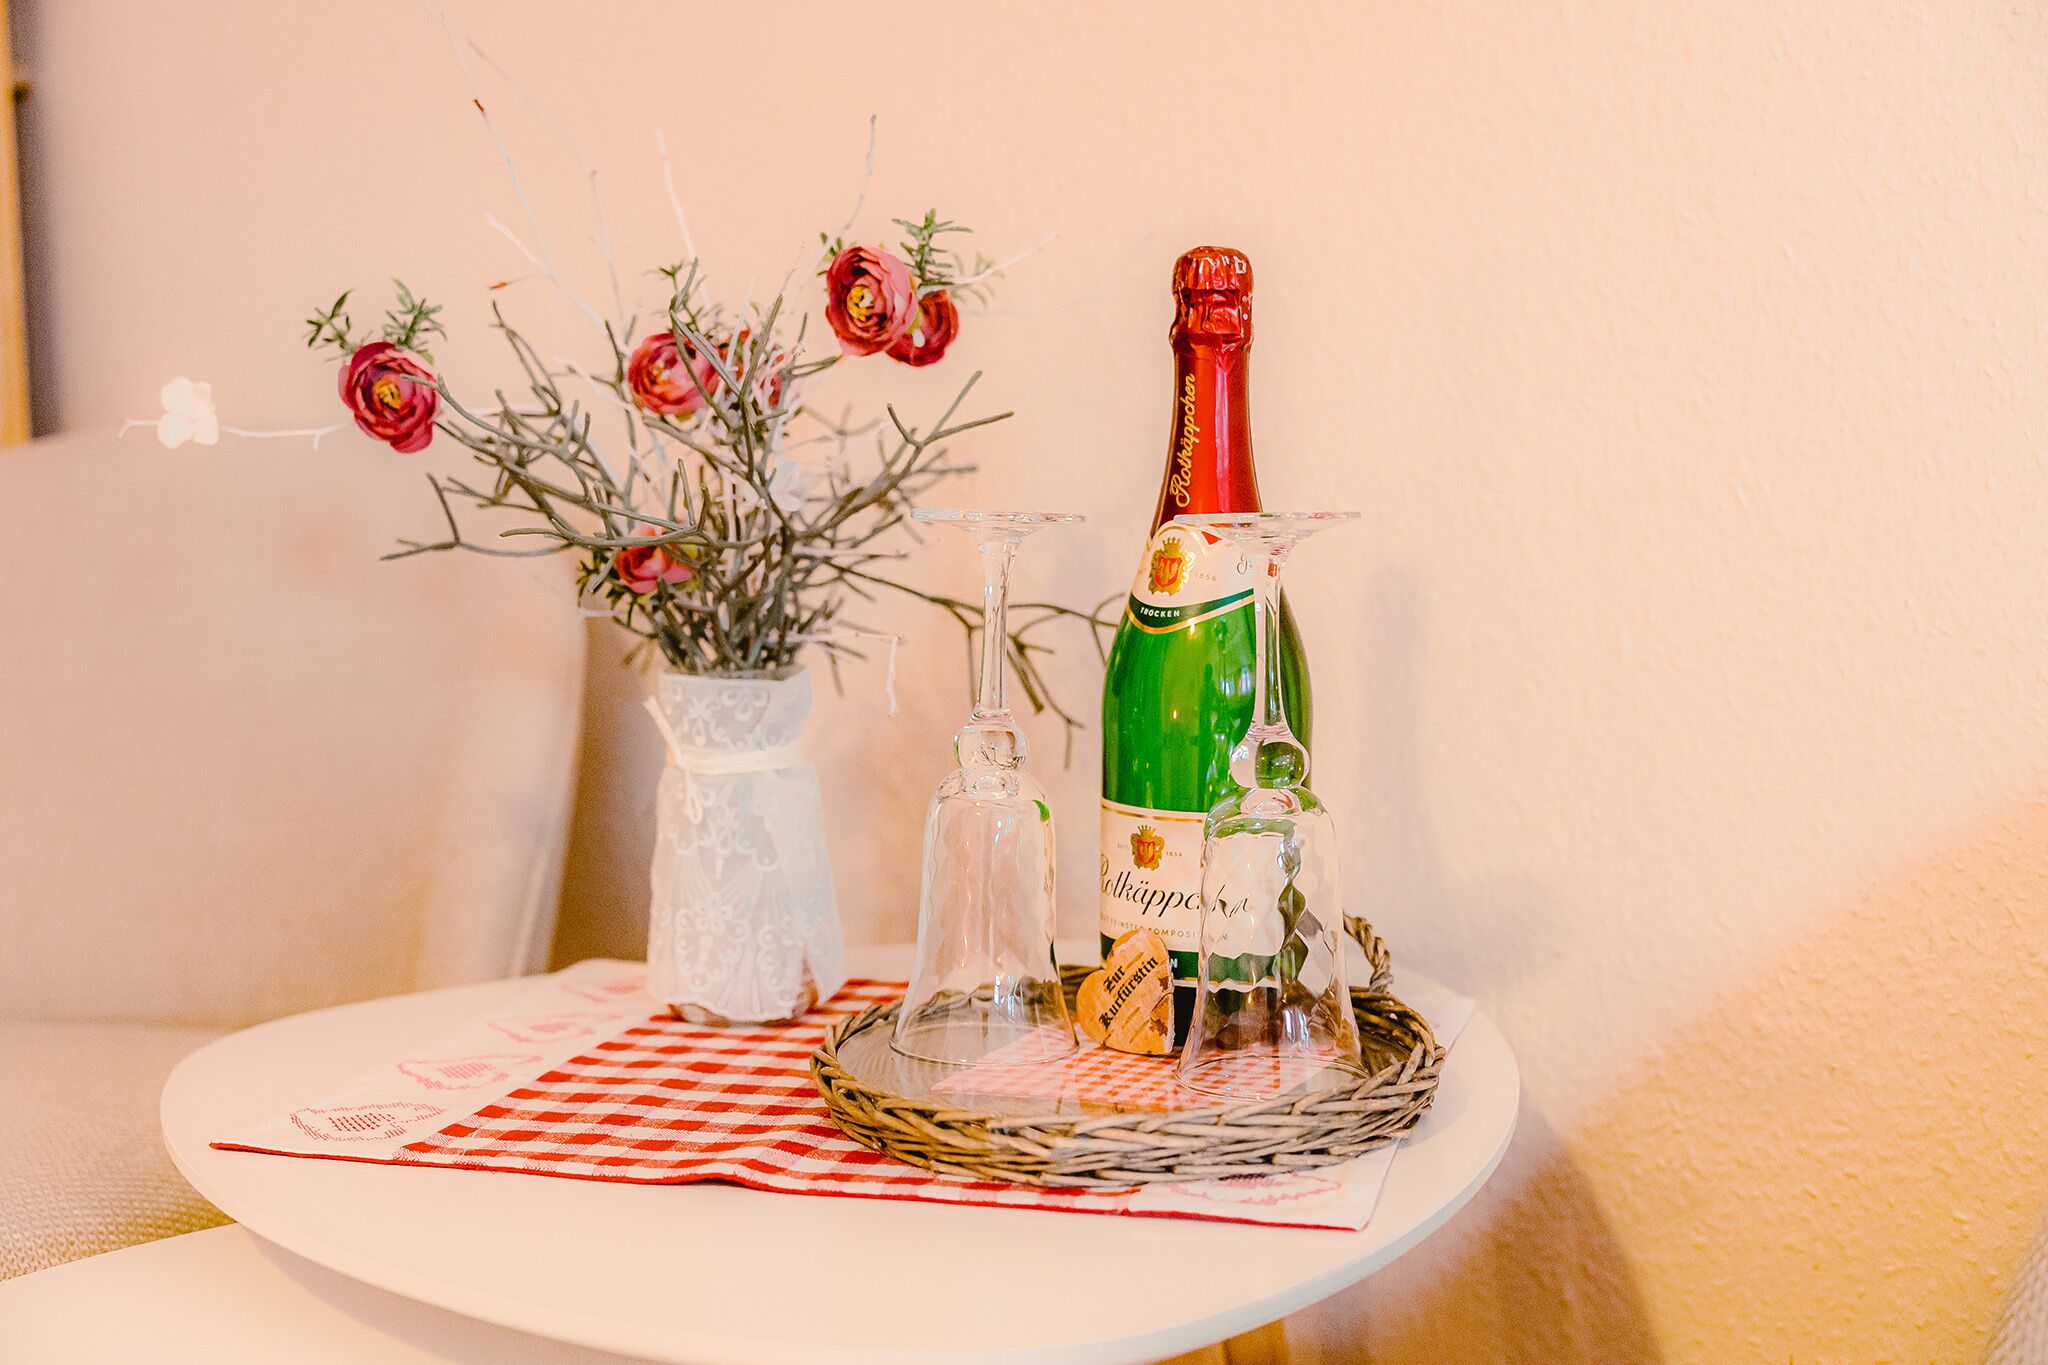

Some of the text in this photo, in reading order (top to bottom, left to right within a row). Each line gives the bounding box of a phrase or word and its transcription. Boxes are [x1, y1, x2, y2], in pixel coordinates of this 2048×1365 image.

[1169, 373, 1200, 507] Rotkäppchen
[1140, 606, 1180, 618] TROCKEN
[1099, 957, 1159, 1030] Kurfürstin
[1103, 966, 1126, 994] Zur
